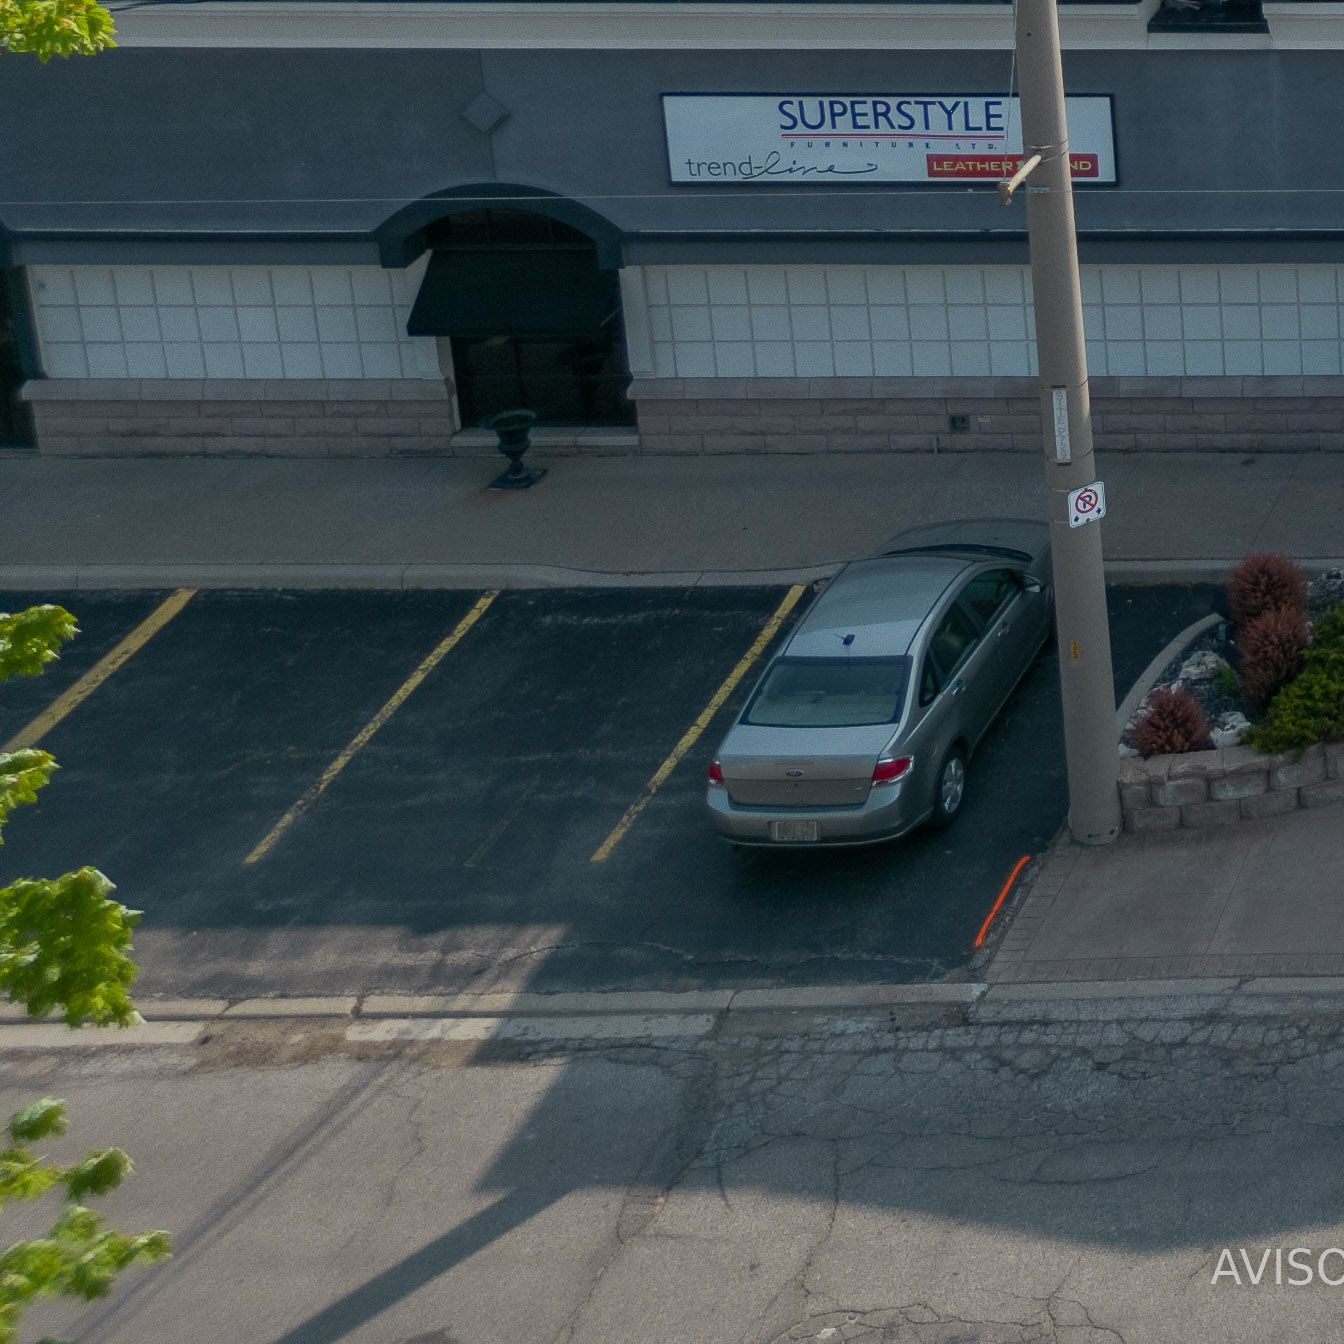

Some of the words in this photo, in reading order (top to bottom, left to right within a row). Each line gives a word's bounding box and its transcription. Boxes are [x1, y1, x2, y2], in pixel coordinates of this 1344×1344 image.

[778, 99, 1004, 131] SUPERSTYLE
[790, 141, 931, 150] FURNITURE
[933, 160, 1013, 171] LEATHER
